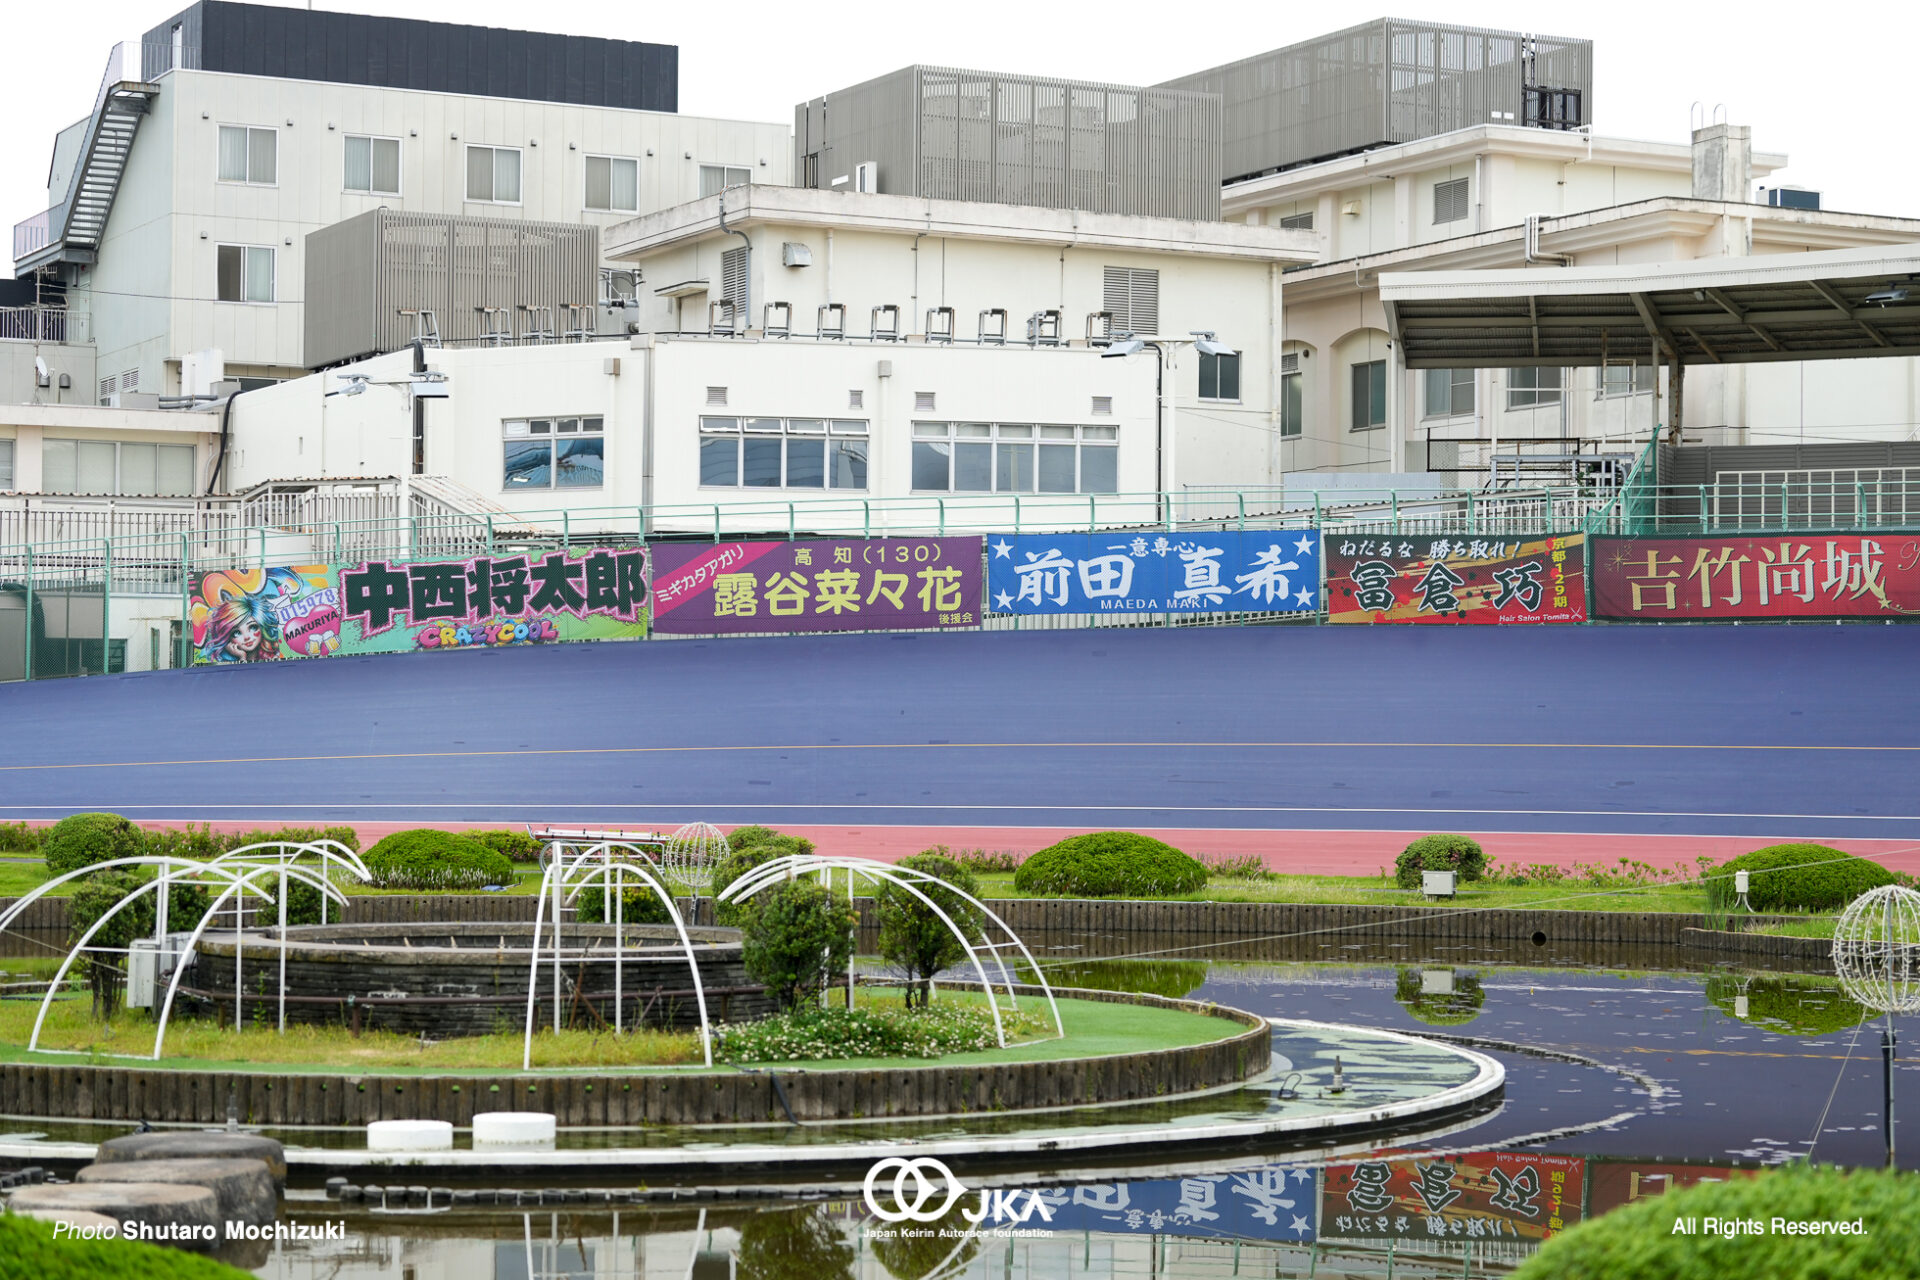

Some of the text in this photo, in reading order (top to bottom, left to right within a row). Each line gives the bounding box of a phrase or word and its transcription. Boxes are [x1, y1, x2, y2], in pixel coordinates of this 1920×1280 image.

[1106, 536, 1195, 558] 一意専心
[1340, 540, 1414, 558] ねだるな
[656, 544, 744, 602] ミギカタアガリ
[1551, 537, 1569, 609] 京都129期
[1622, 539, 1887, 611] 吉竹尚城
[342, 549, 648, 636] 中西将太郎
[712, 565, 963, 617] 露谷菜々花
[1101, 598, 1208, 609] MAEDA MAKI
[285, 610, 339, 641] MAKURIYA
[938, 612, 973, 625] 後援会
[1499, 612, 1570, 622] Hair Salon Tomita
